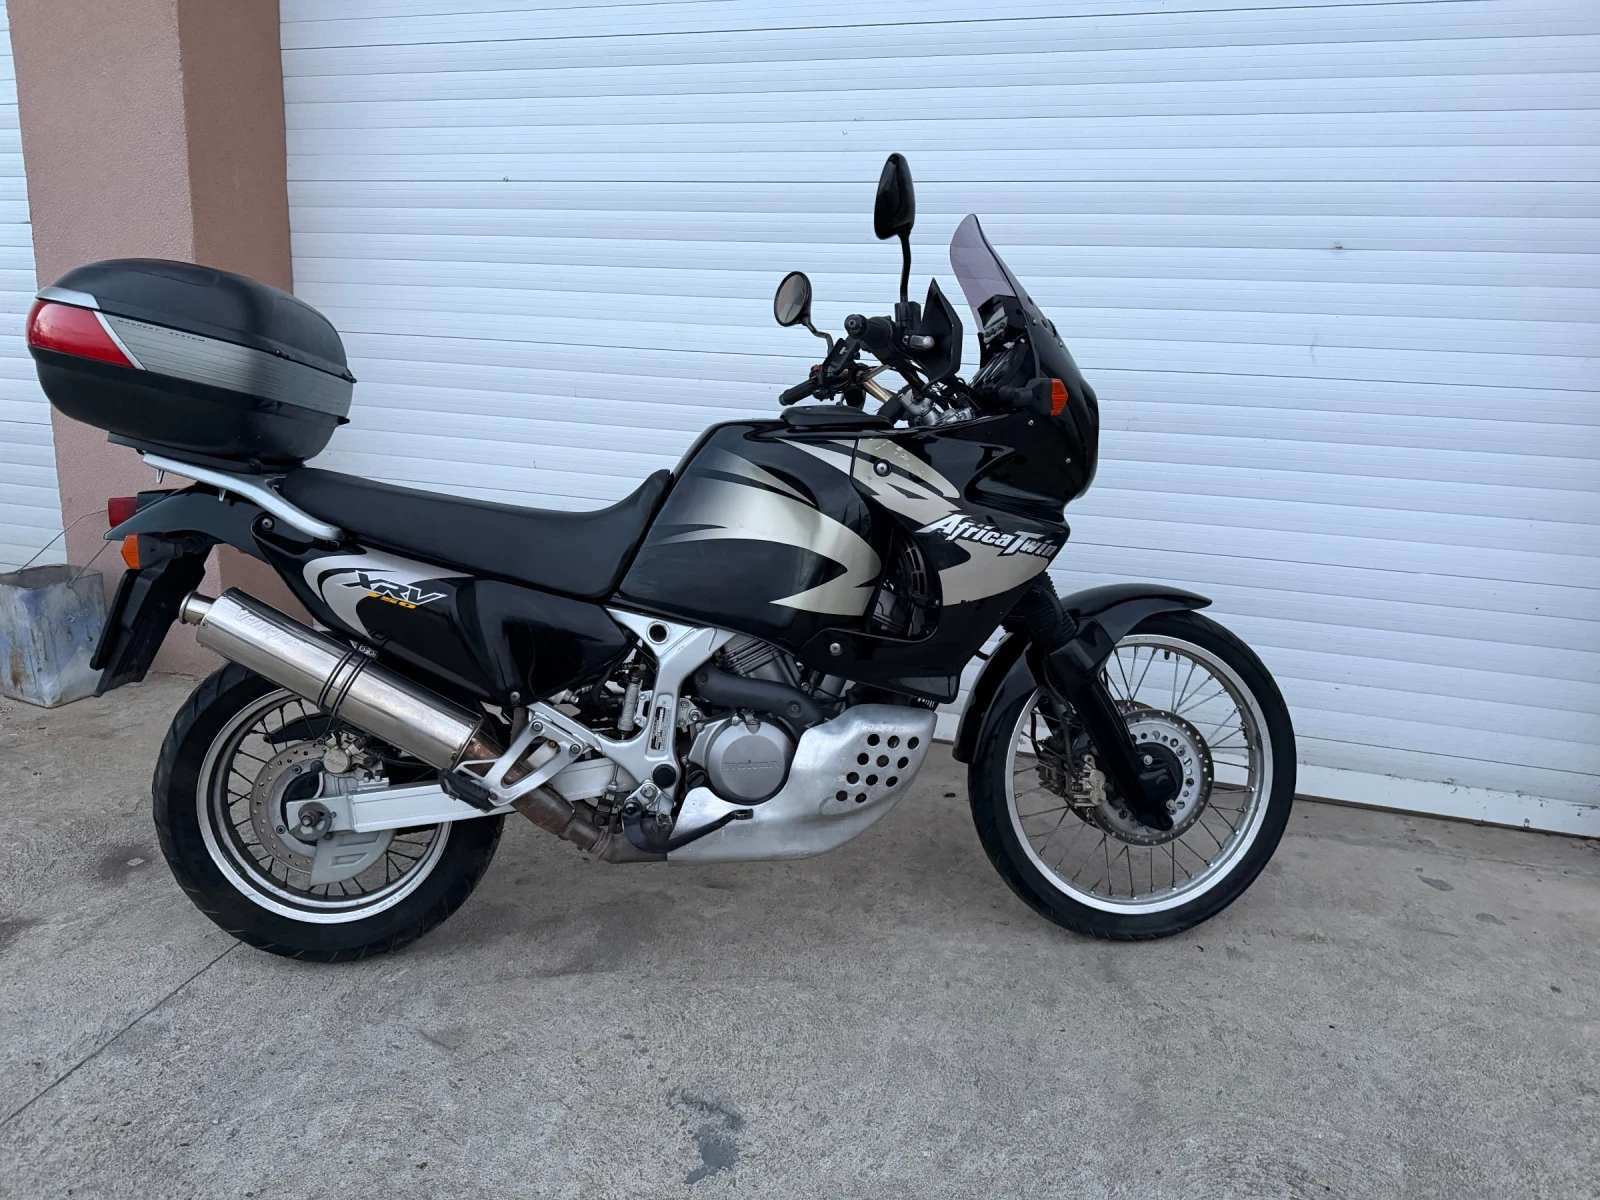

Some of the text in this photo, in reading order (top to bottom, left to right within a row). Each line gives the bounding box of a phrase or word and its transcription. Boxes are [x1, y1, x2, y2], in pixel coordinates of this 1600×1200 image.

[920, 513, 1058, 556] Africa Twin
[338, 570, 447, 606] XRV
[723, 759, 781, 771] HONDA
